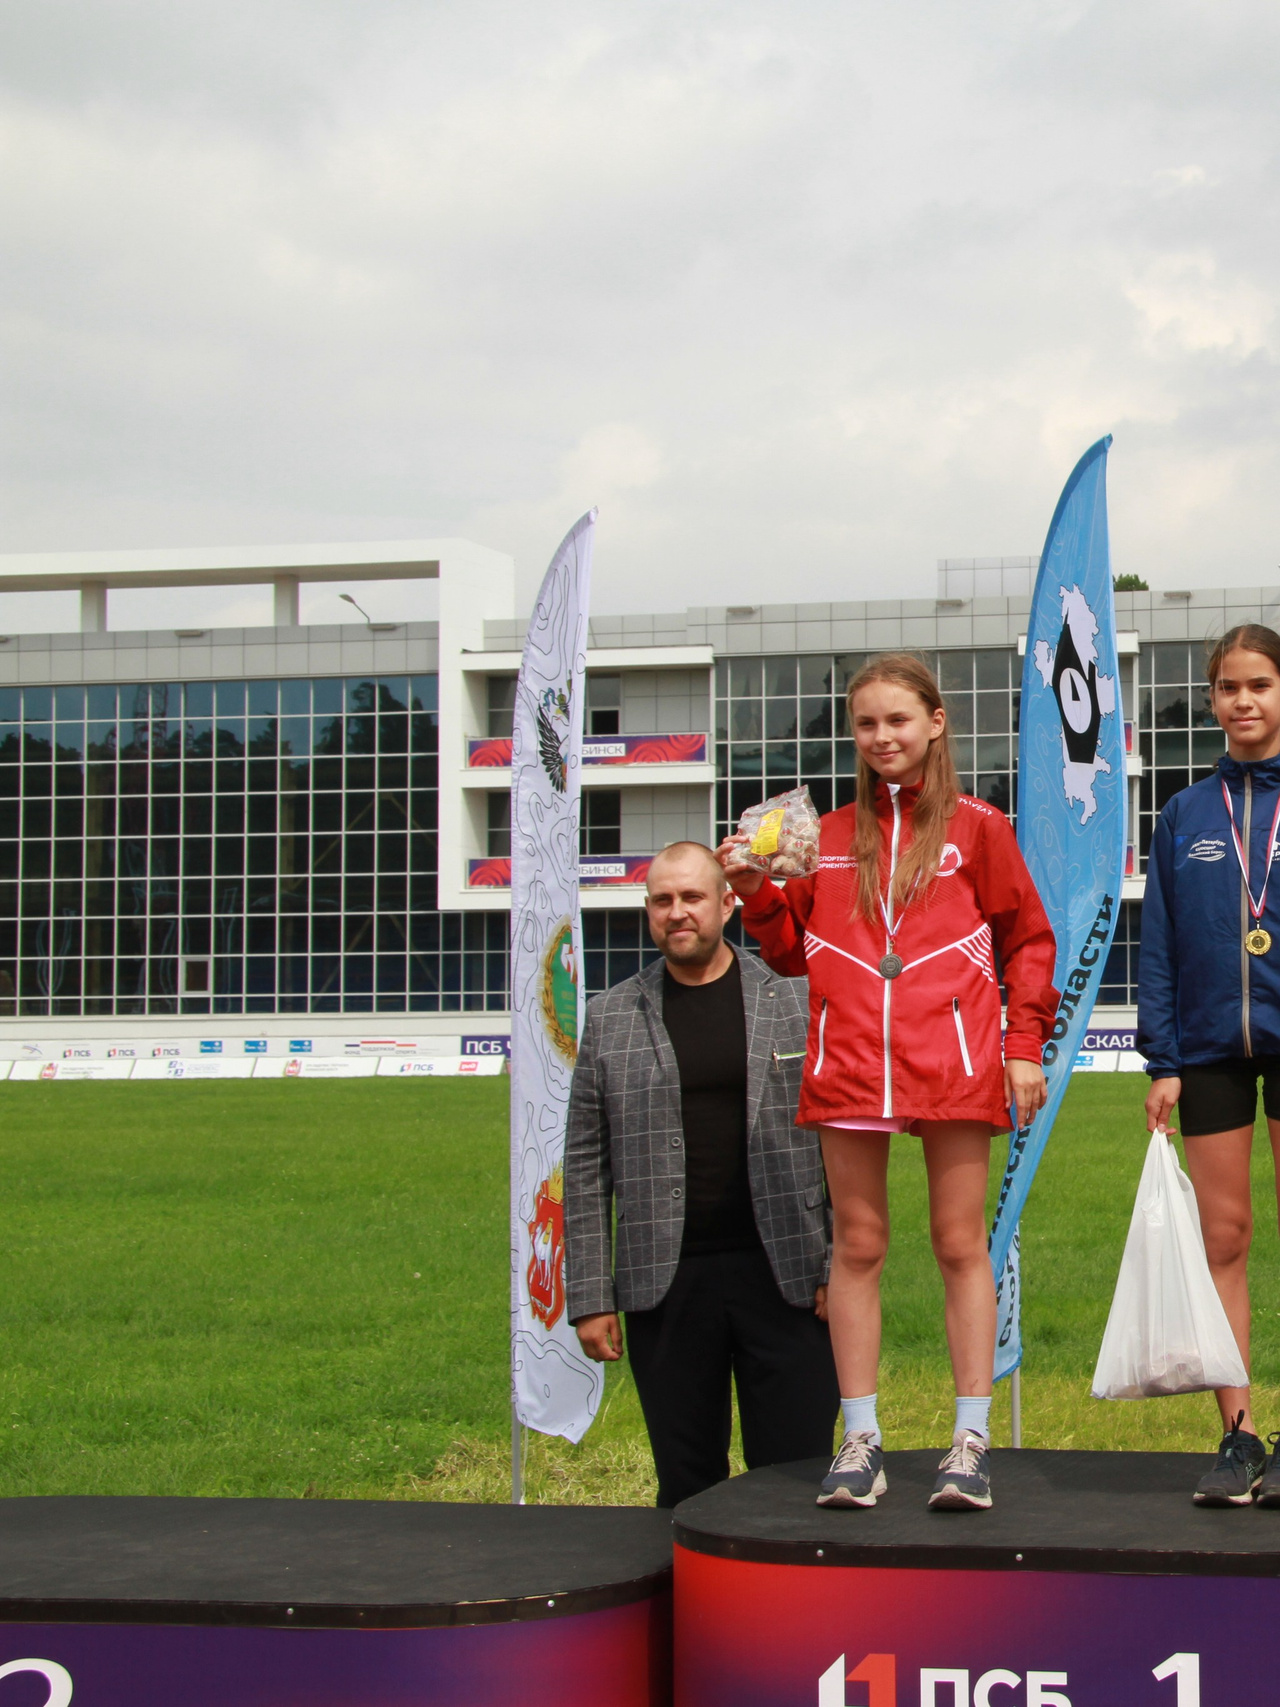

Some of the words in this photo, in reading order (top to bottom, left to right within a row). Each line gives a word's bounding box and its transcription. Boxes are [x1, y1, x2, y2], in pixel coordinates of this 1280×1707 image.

[578, 865, 623, 875] БИНСК
[1042, 893, 1114, 1068] области
[465, 1040, 503, 1055] ПСБ
[1081, 1034, 1135, 1049] СКАЯ
[413, 1063, 434, 1071] ПСБ
